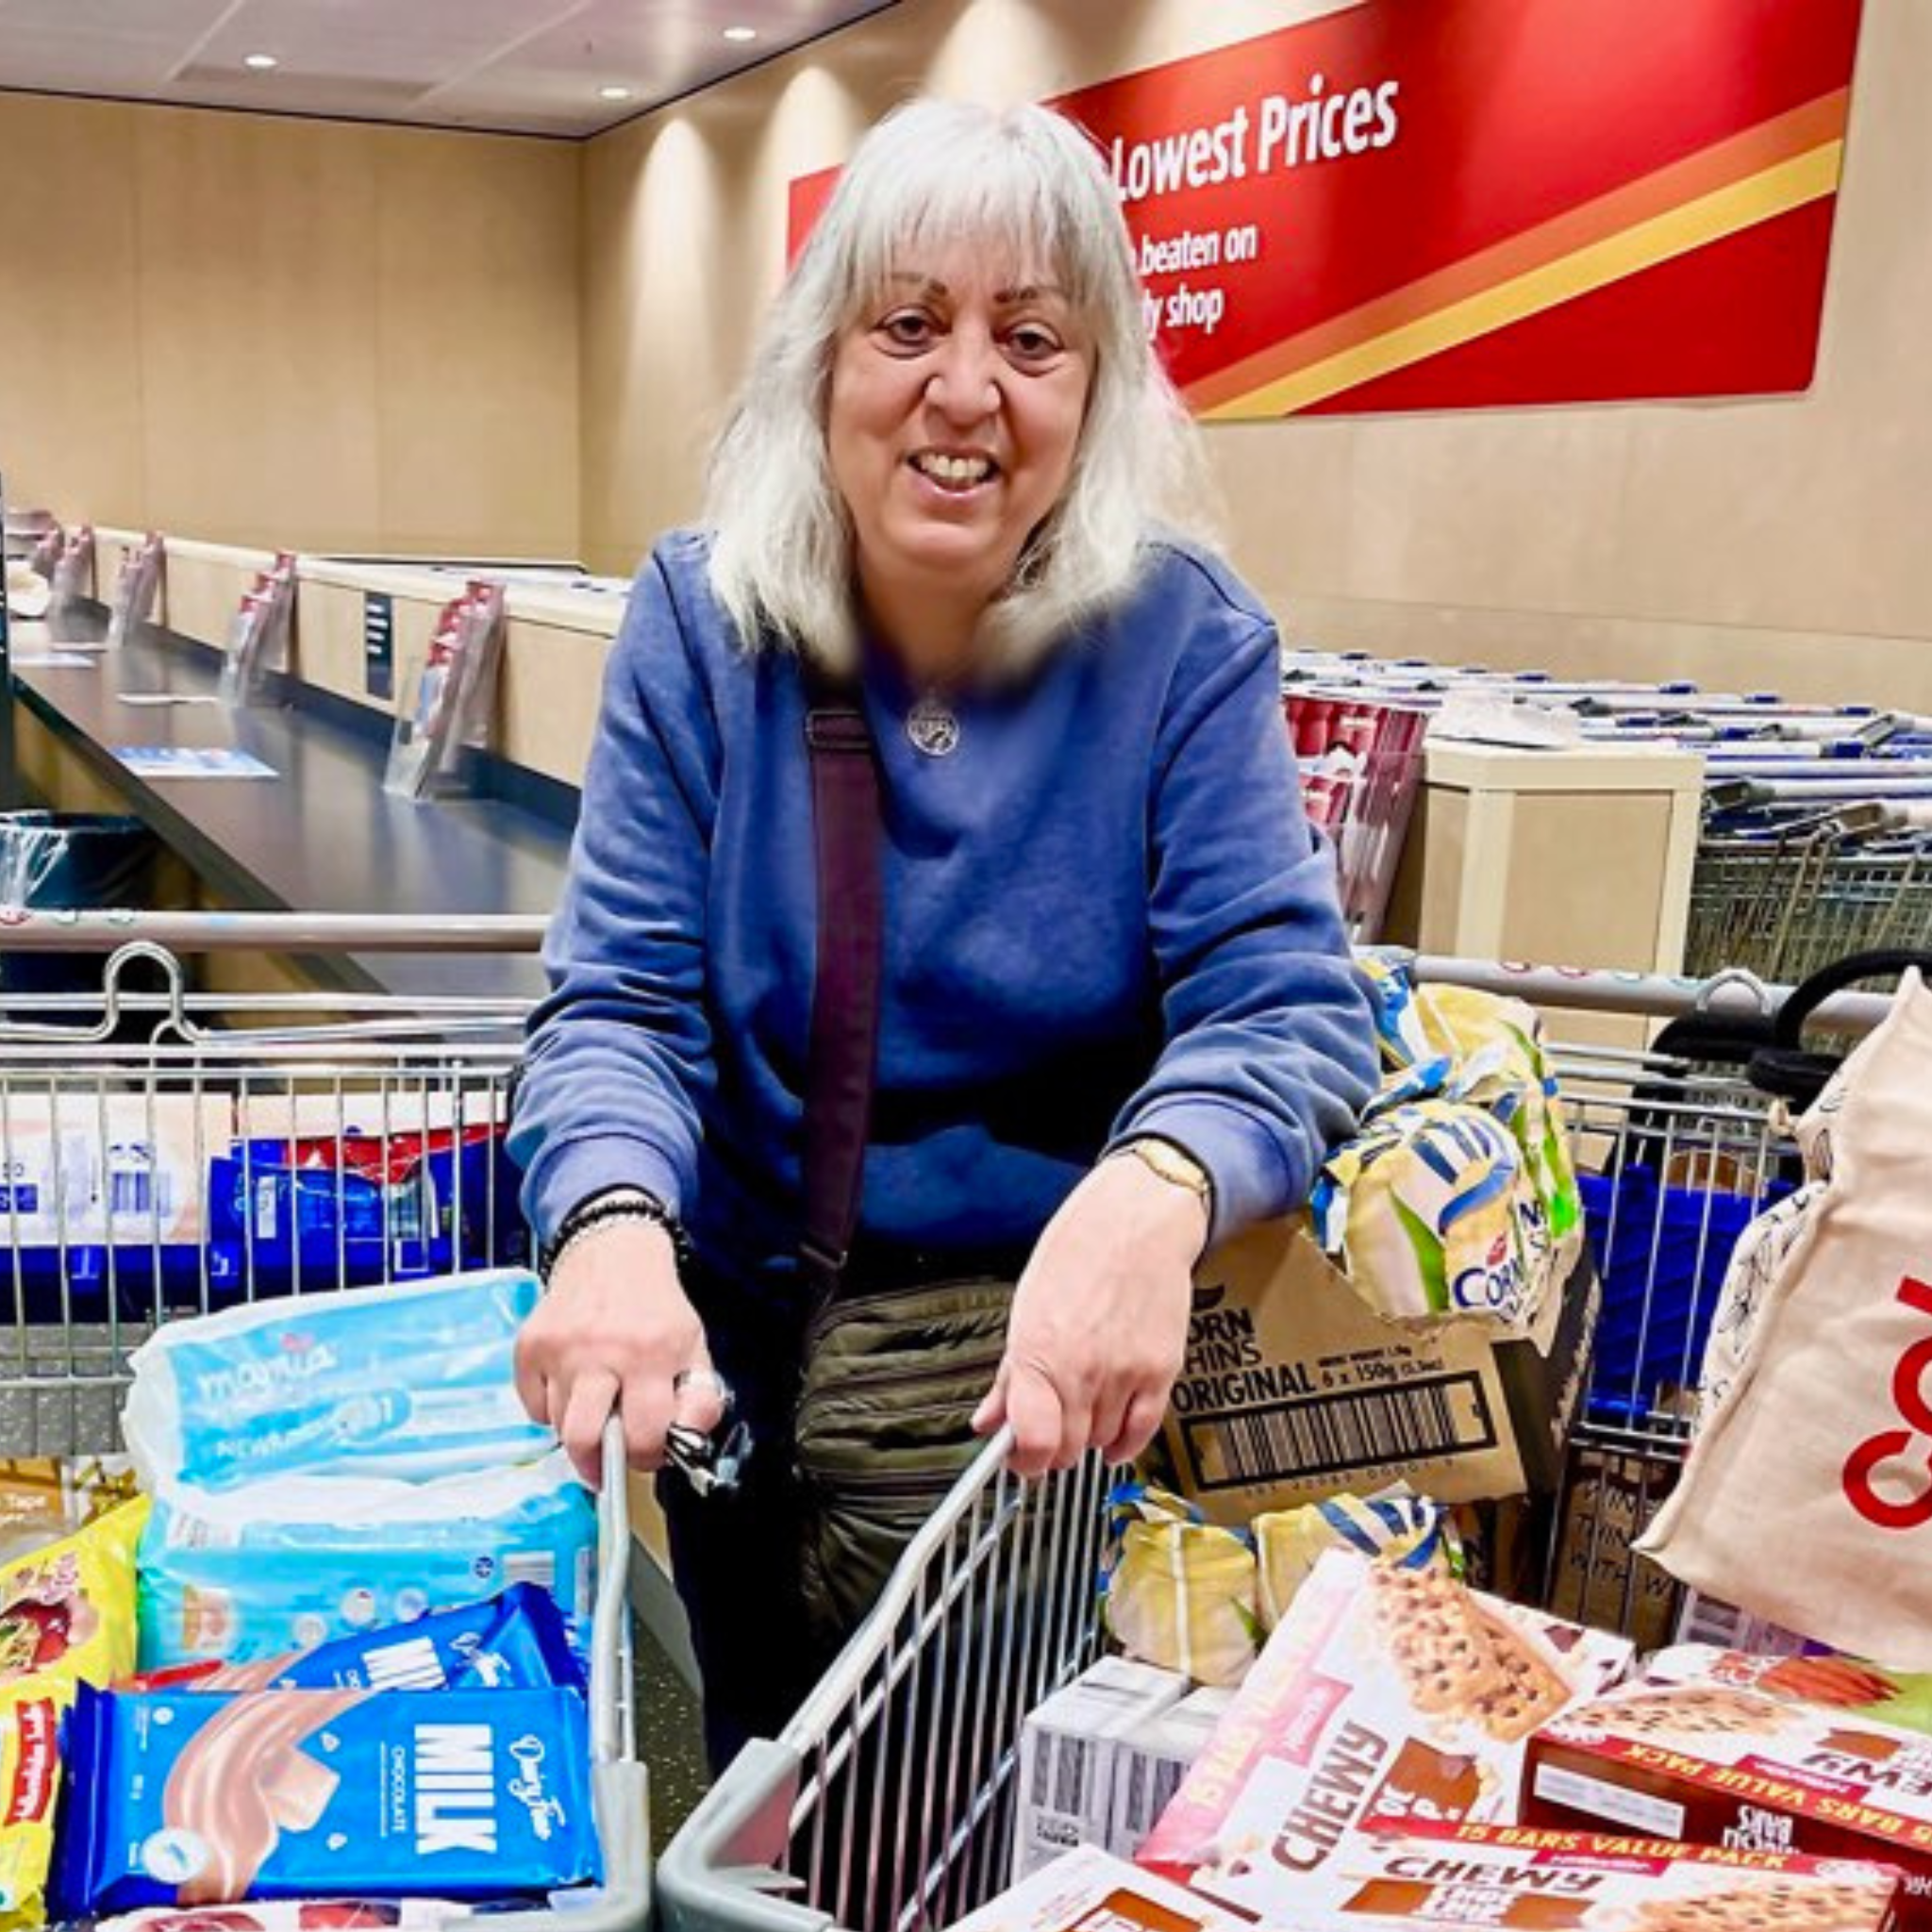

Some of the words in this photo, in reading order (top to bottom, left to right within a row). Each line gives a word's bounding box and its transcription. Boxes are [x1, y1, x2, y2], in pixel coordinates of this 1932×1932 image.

[1112, 106, 1249, 201] Lowest
[1257, 74, 1398, 173] Prices
[1141, 227, 1220, 275] beaten
[1224, 224, 1257, 263] on
[1166, 282, 1224, 335] shop
[1187, 1308, 1254, 1345] ORN
[1185, 1338, 1262, 1374] HINS
[1322, 1369, 1334, 1389] 6
[1171, 1361, 1317, 1413] ORIGINAL
[507, 1734, 545, 1805] Dairy
[1623, 1742, 1706, 1777] PACK
[391, 1745, 407, 1834] CHOCOLATE
[414, 1724, 498, 1855] MILK
[1272, 1722, 1390, 1873] CHEWY
[1711, 1766, 1805, 1807] VALUE
[1815, 1796, 1903, 1834] BARS
[1498, 1828, 1580, 1851] BARS
[1591, 1837, 1690, 1860] VALUE
[1700, 1845, 1789, 1869] PACK
[1384, 1857, 1605, 1892] CHEWY
